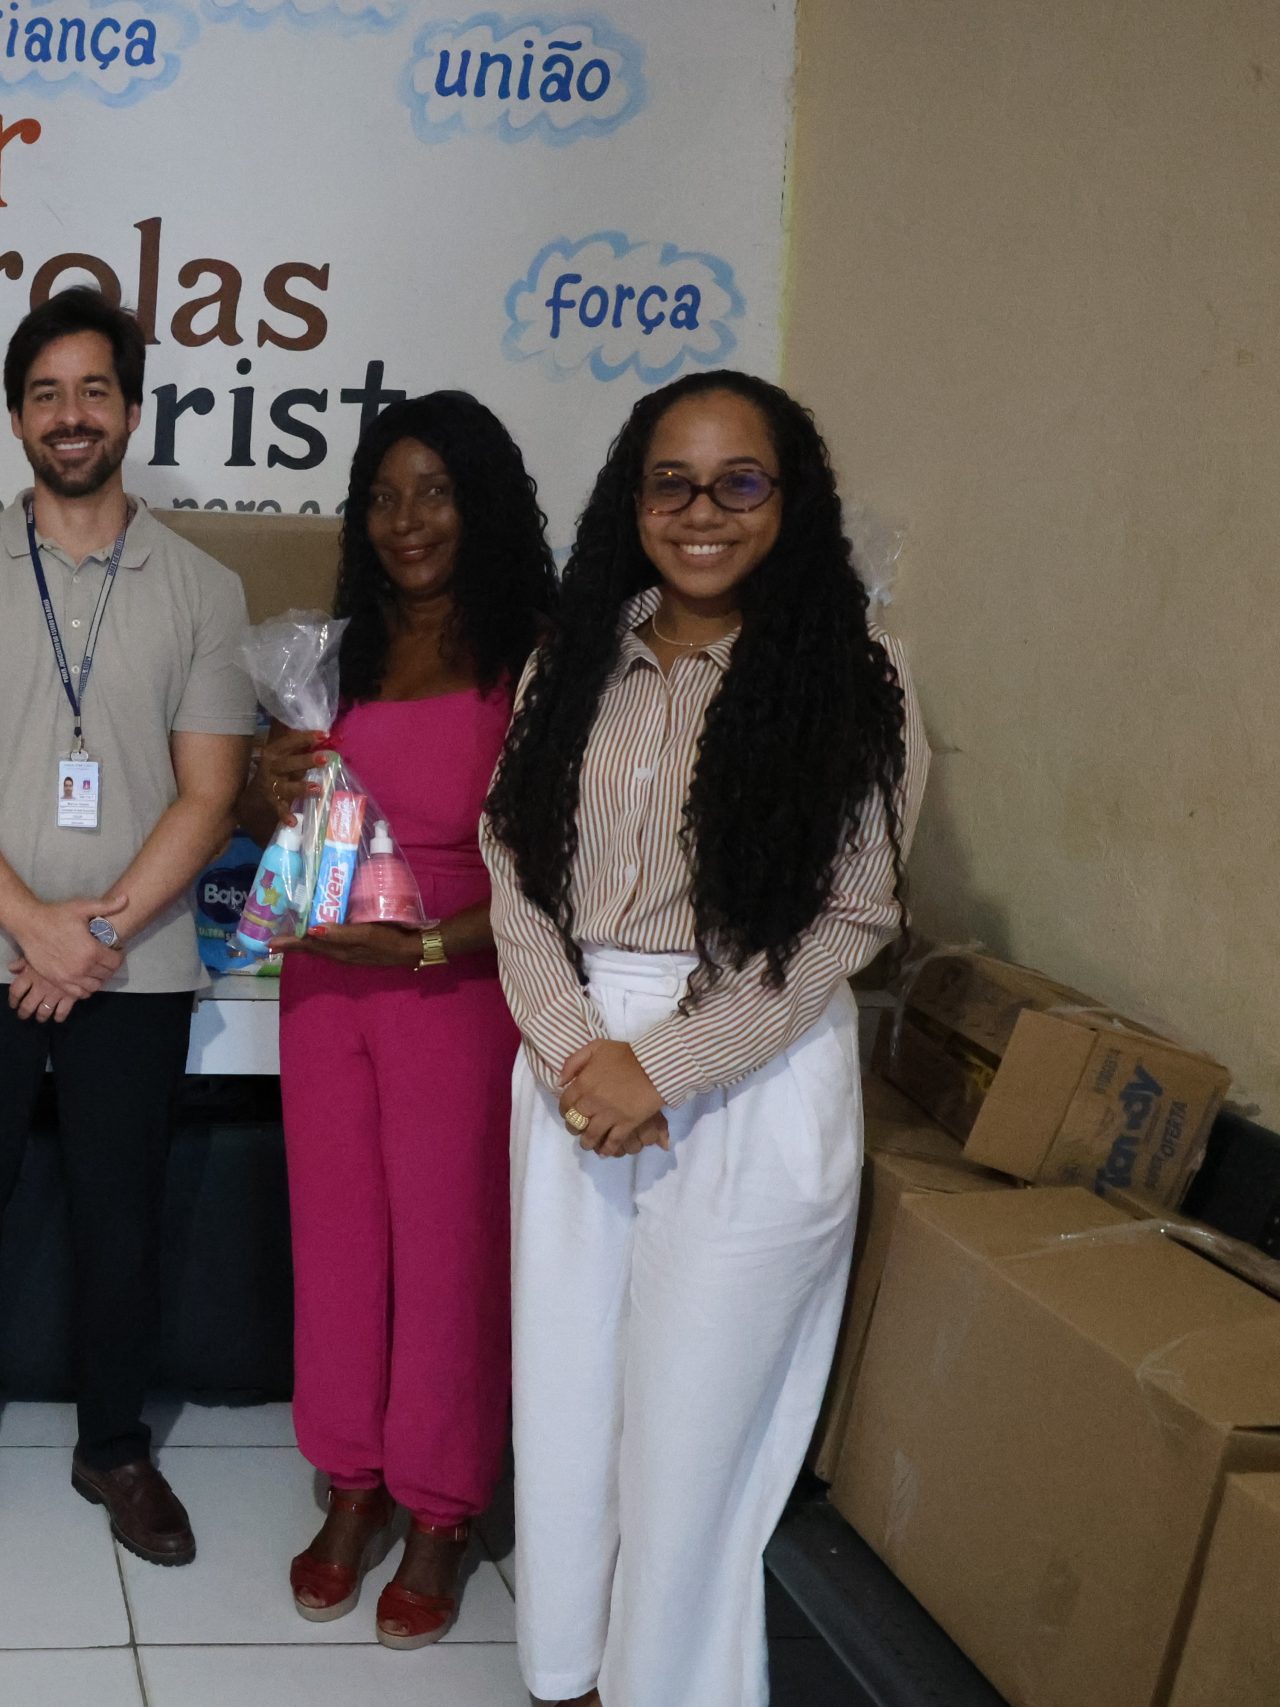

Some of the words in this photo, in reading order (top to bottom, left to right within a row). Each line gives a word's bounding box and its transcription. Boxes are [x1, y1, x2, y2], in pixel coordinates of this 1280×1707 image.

[434, 39, 611, 102] união
[545, 273, 701, 338] força
[147, 358, 406, 470] rist
[316, 865, 346, 924] Even
